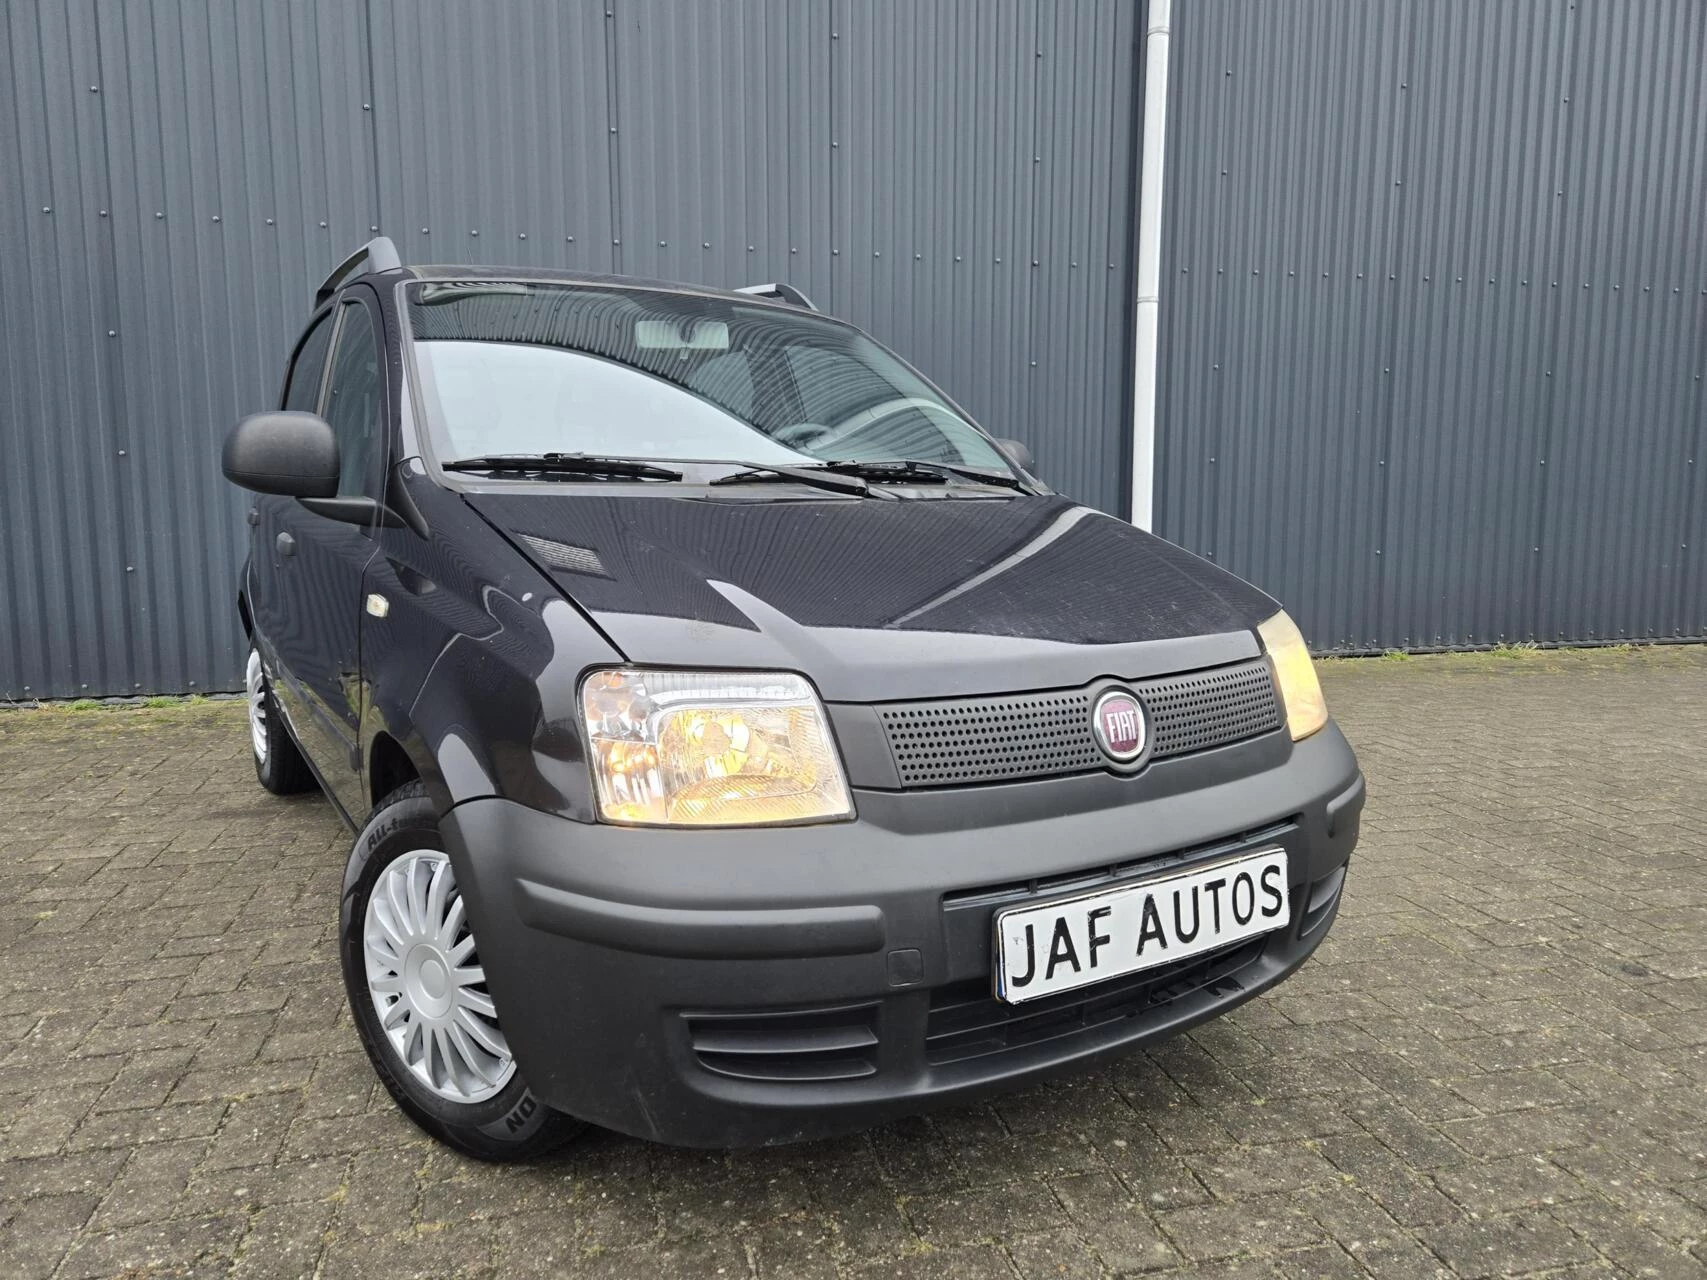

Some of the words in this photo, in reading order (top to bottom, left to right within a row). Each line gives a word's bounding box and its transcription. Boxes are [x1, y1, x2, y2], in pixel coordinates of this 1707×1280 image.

[1105, 710, 1137, 743] FIAT
[1011, 906, 1112, 987] JAF
[1136, 865, 1282, 957] AUTOS
